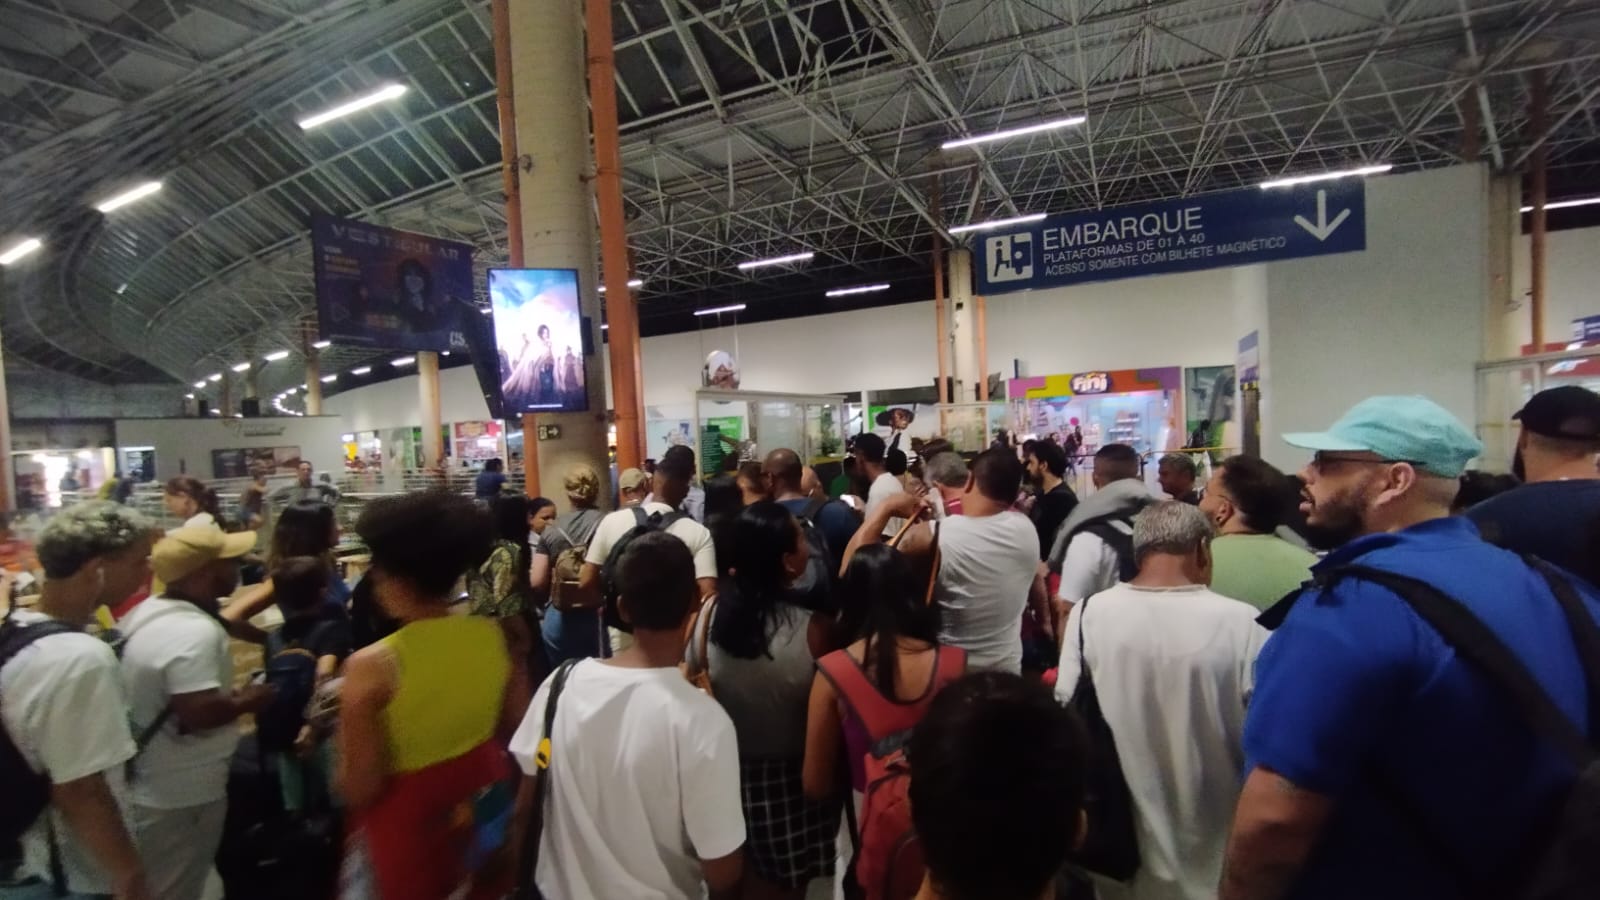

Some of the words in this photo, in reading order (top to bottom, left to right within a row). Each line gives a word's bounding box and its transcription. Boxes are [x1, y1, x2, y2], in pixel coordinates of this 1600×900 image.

[1043, 207, 1202, 250] EMBARQUE
[1043, 242, 1133, 264] PLATAFORMAS
[1136, 239, 1155, 251] DE
[1158, 237, 1172, 248] 01
[1190, 232, 1205, 244] 40
[1045, 262, 1086, 276] ACESSO
[1088, 255, 1139, 271] SOMENTE
[1142, 252, 1167, 264] COM
[1169, 245, 1214, 261] BILHETE
